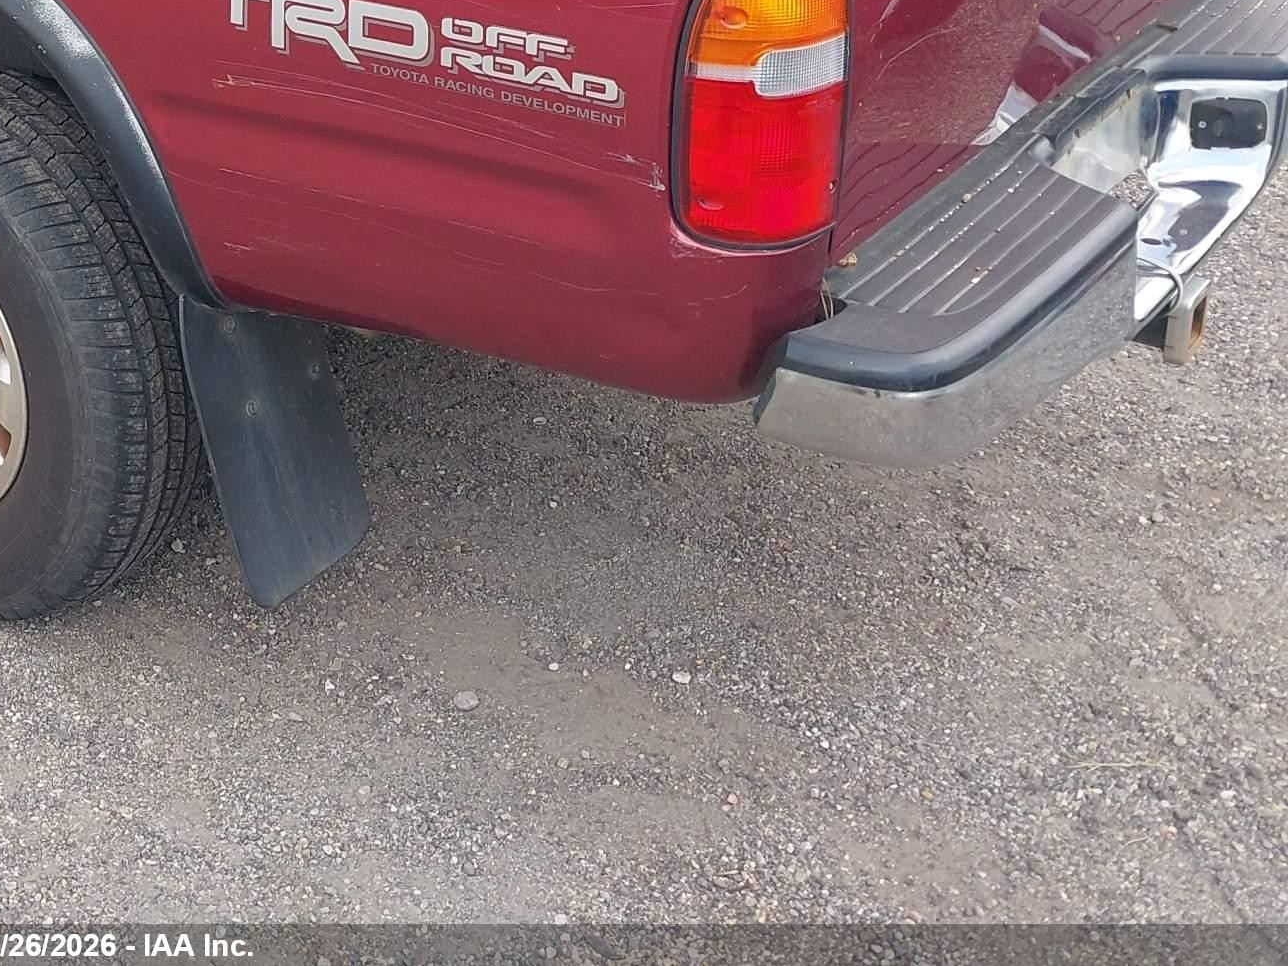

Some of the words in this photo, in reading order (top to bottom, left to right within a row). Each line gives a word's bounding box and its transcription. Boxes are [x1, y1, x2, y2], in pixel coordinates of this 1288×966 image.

[441, 17, 574, 60] OFF
[370, 63, 429, 84] TOYOTA
[434, 76, 495, 99] RACING
[500, 92, 624, 127] DEVELOPMENT
[440, 46, 624, 108] ROAD
